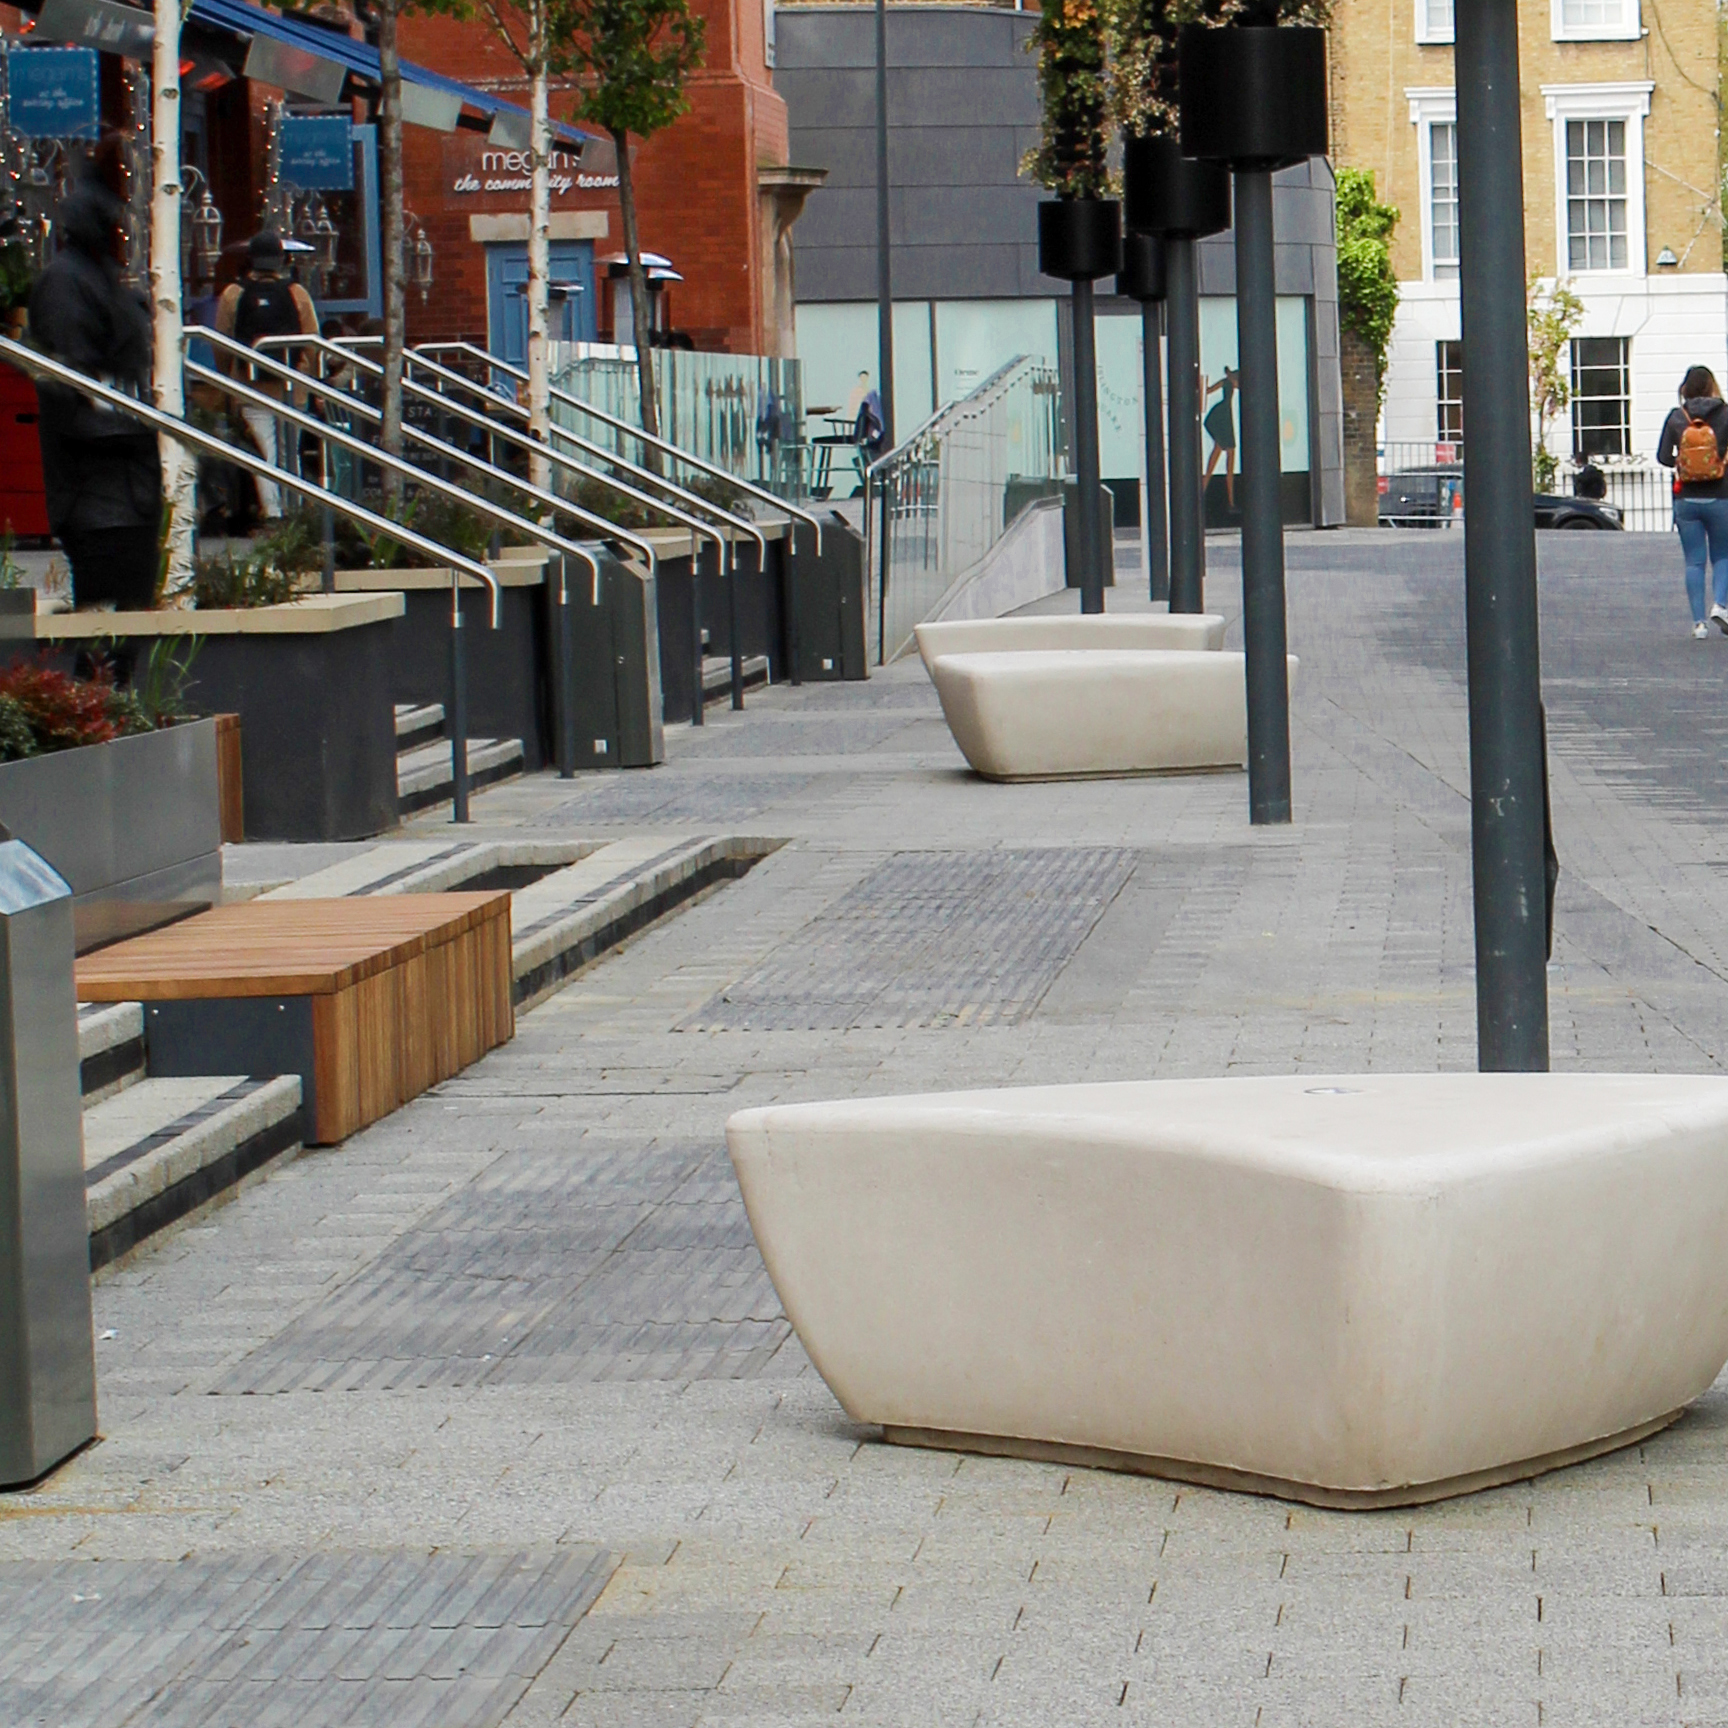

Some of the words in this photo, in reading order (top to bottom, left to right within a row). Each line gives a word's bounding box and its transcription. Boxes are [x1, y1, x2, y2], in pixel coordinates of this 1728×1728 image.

[482, 151, 581, 176] megn
[454, 174, 481, 191] the
[484, 174, 573, 195] commuity
[576, 174, 620, 189] room
